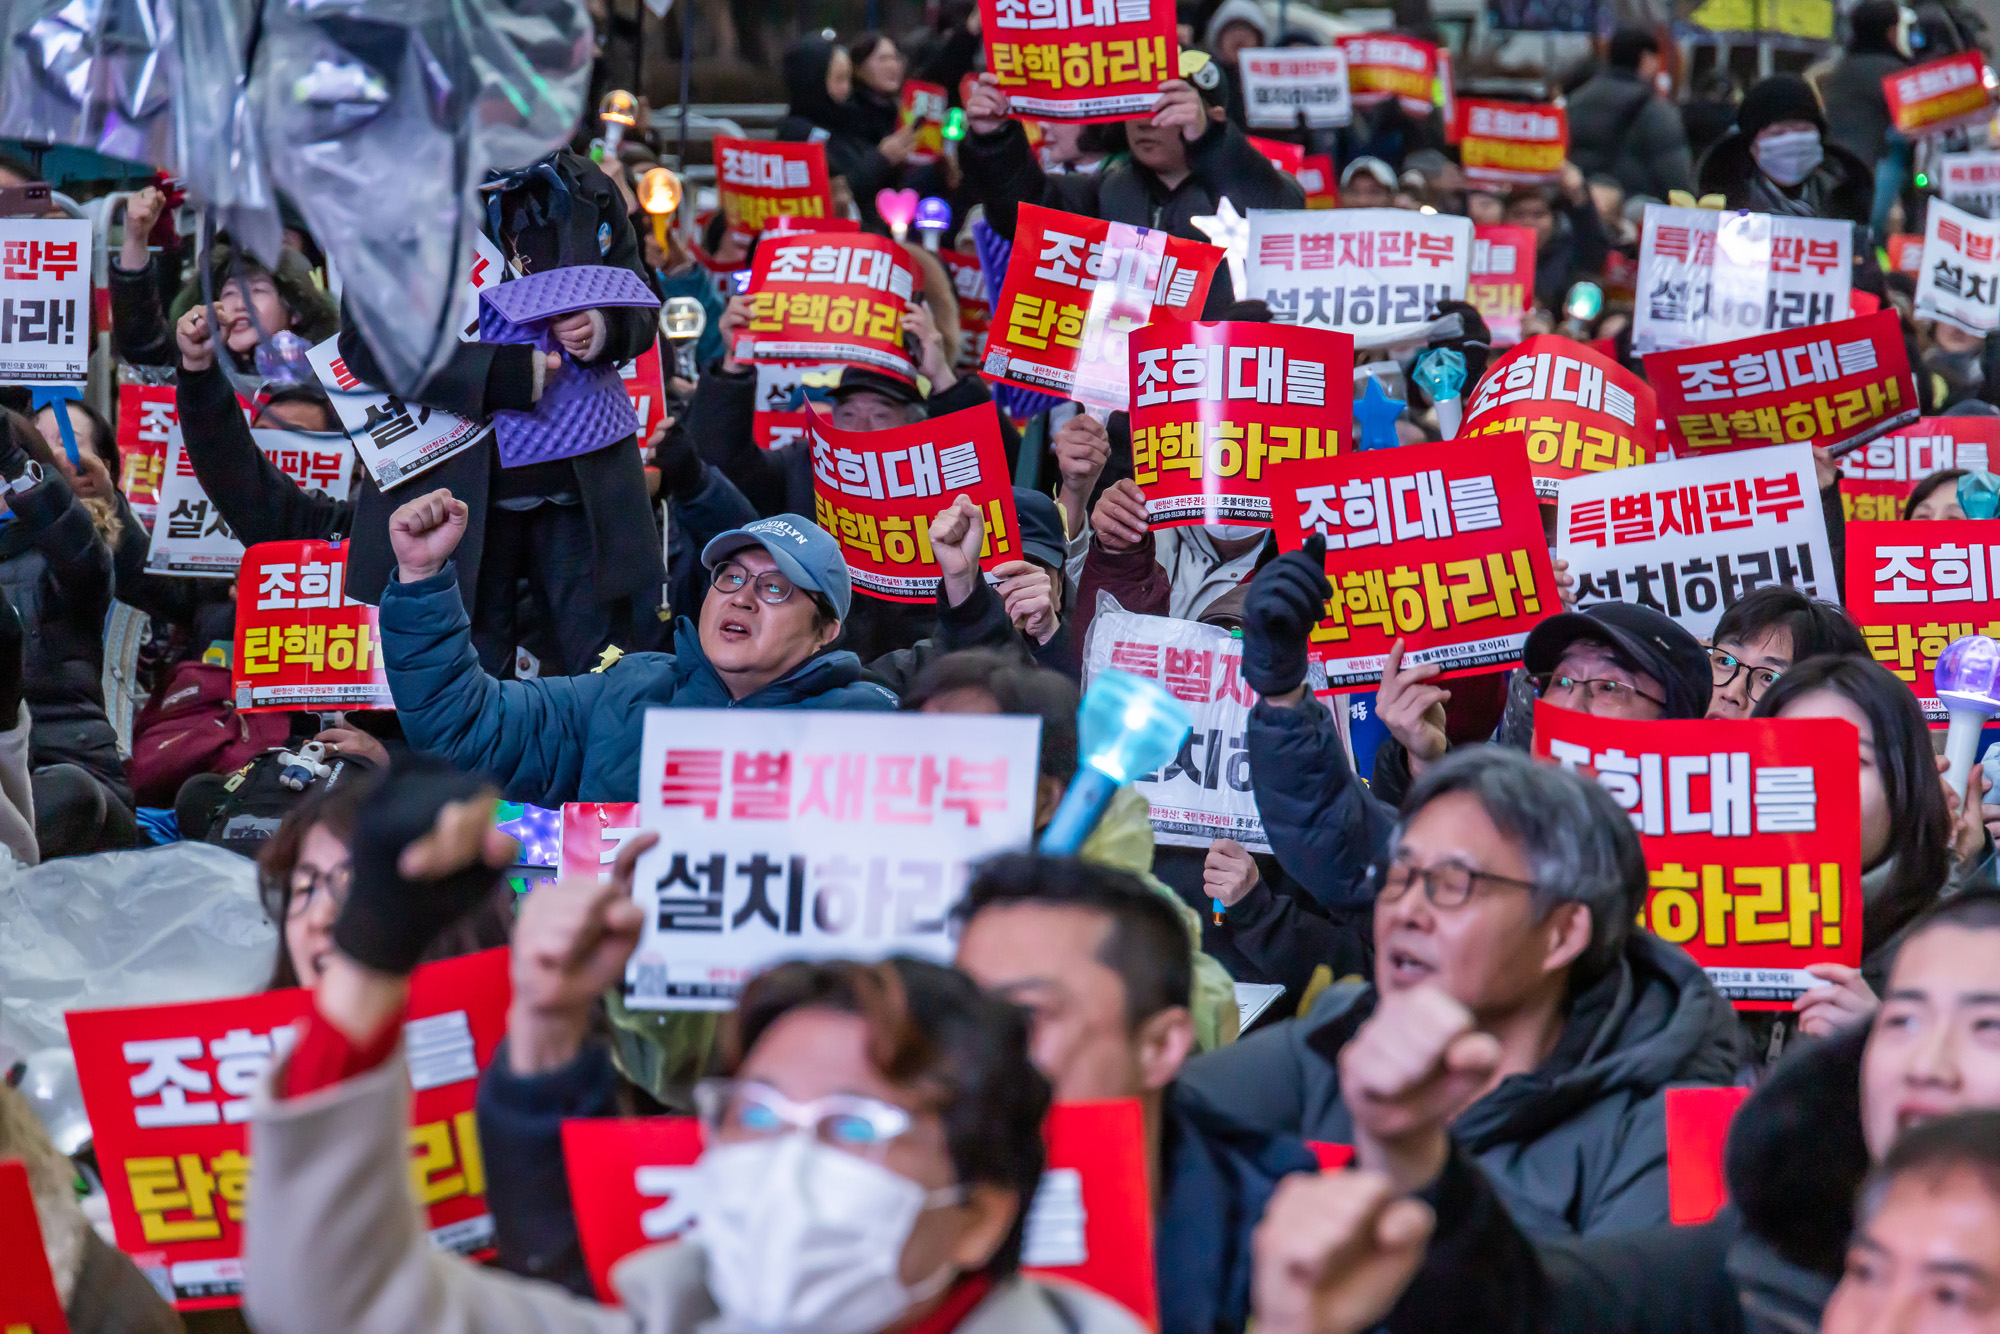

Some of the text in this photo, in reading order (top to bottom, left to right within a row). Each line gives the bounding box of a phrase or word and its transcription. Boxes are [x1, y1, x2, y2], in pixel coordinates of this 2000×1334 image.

[992, 36, 1168, 89] 탄핵하라!
[721, 148, 811, 189] 조희대를
[3, 241, 78, 281] 판부
[1259, 230, 1454, 271] 특별재판부
[1654, 225, 1839, 275] 특별판부
[1937, 217, 2000, 263] 특별
[766, 245, 914, 302] 조희대를
[1138, 344, 1326, 408] 조희대를
[1467, 353, 1636, 428] 조희대를
[1678, 338, 1879, 402] 조희대를
[1677, 375, 1901, 447] 탄핵하라!
[812, 427, 982, 500] 조희대를
[815, 489, 1011, 564] 탄핵하!
[1221, 497, 1271, 508] 촛불대행진으
[1296, 469, 1502, 550] 조희대를
[1569, 472, 1804, 548] 특별재판부
[748, 520, 808, 544] BROOKLYN
[1874, 543, 2000, 603] 조희
[244, 624, 386, 674] 탄핵하
[1919, 699, 1942, 709] 청산!
[661, 749, 1009, 827] 특별재판부
[1637, 863, 1842, 947] 하라!
